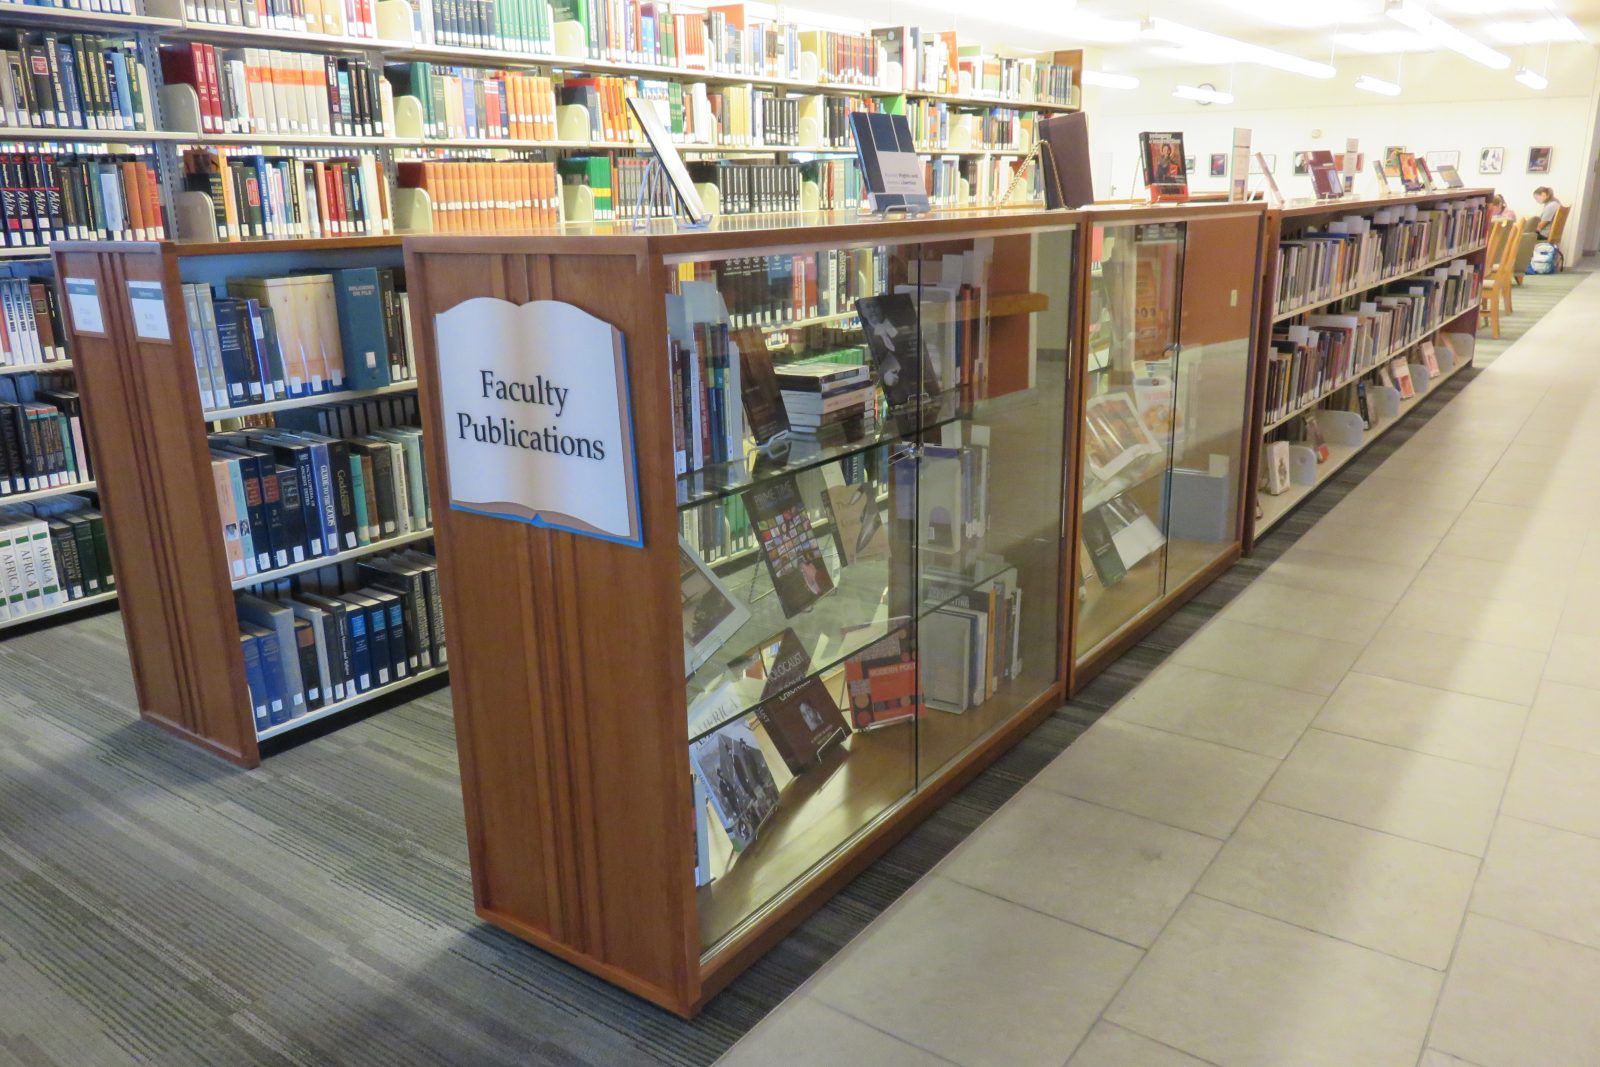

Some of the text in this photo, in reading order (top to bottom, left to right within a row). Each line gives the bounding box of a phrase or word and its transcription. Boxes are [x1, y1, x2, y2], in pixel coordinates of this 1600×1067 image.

[4, 190, 16, 216] China
[18, 191, 30, 216] China
[34, 190, 46, 215] China
[49, 190, 60, 215] China
[480, 370, 569, 417] Faculty
[456, 412, 606, 460] Publications
[320, 465, 329, 488] GUIDE
[326, 505, 335, 527] GODS
[3, 554, 20, 592] AFRICA
[21, 550, 37, 588] AFRICA
[39, 546, 56, 584] AFRICA
[62, 539, 76, 580] HISTORY
[869, 665, 898, 676] MODERN
